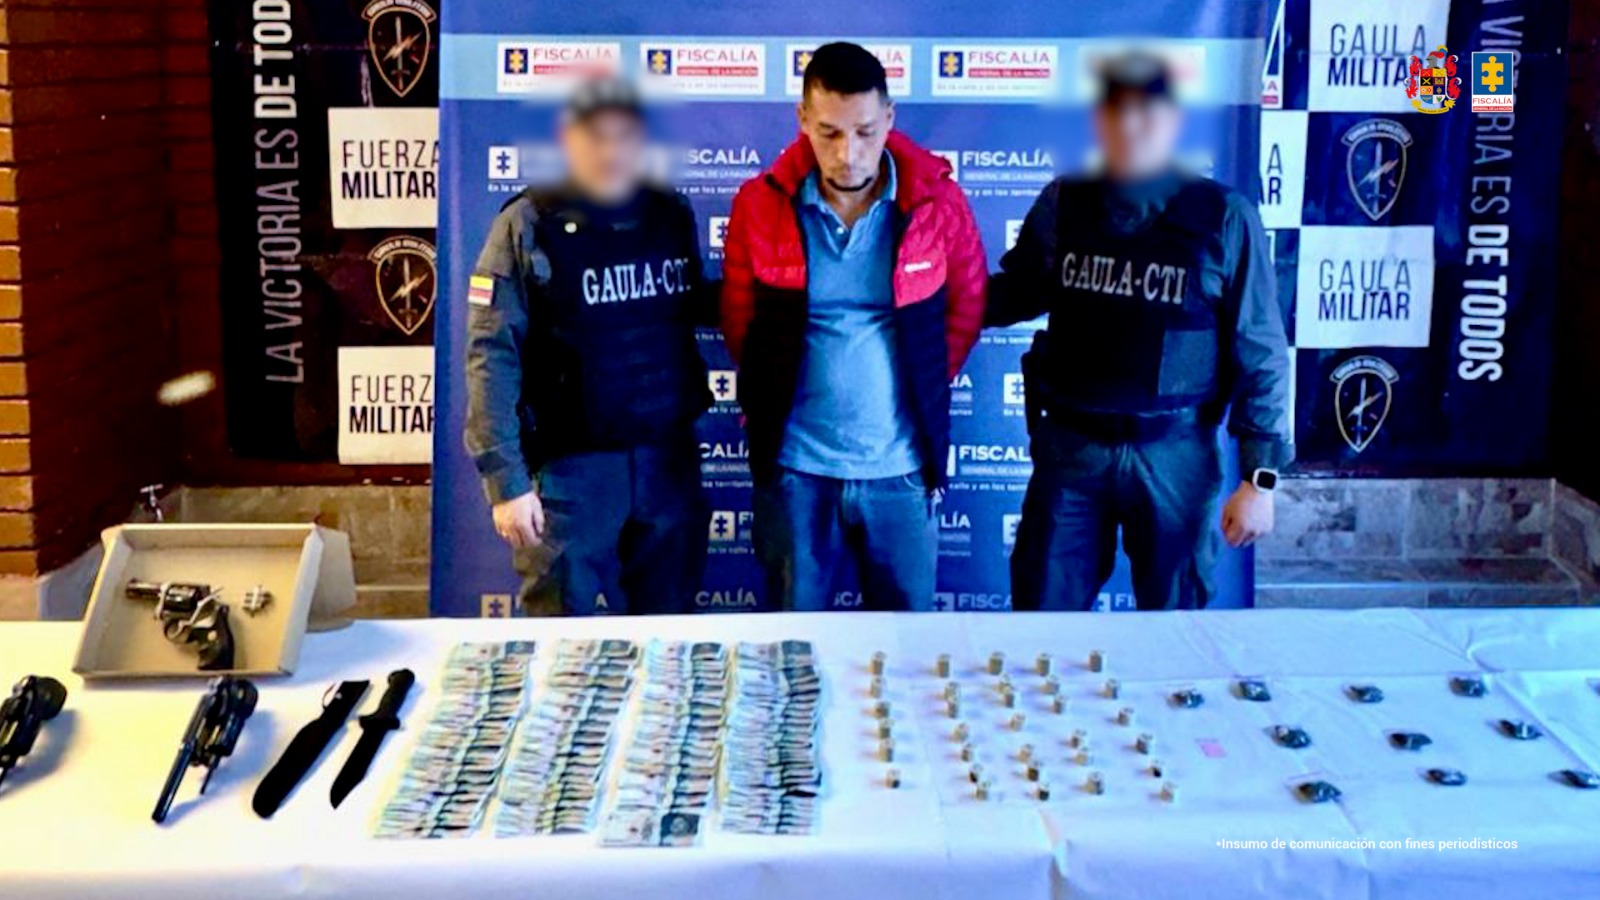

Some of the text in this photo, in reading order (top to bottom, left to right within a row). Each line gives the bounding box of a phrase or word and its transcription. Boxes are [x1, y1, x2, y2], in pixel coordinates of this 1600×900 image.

[677, 47, 757, 62] FISCALÍA
[1330, 24, 1426, 56] GAULA
[969, 50, 1050, 64] FISCALÍA
[1327, 57, 1422, 86] MILITA
[253, 74, 297, 118] DE
[254, 129, 298, 169] ES
[962, 148, 1054, 167] FISCALÍA
[342, 171, 436, 199] MILITAR
[1470, 175, 1511, 214] ES
[257, 180, 303, 330] VICTORIA
[1466, 224, 1509, 266] DE
[1319, 259, 1411, 291] GAULA
[1318, 292, 1411, 321] MILITAR
[1458, 274, 1507, 382] TODOS
[265, 341, 303, 383] LA
[351, 374, 432, 403] FUERZ
[959, 444, 1032, 462] FISCAL
